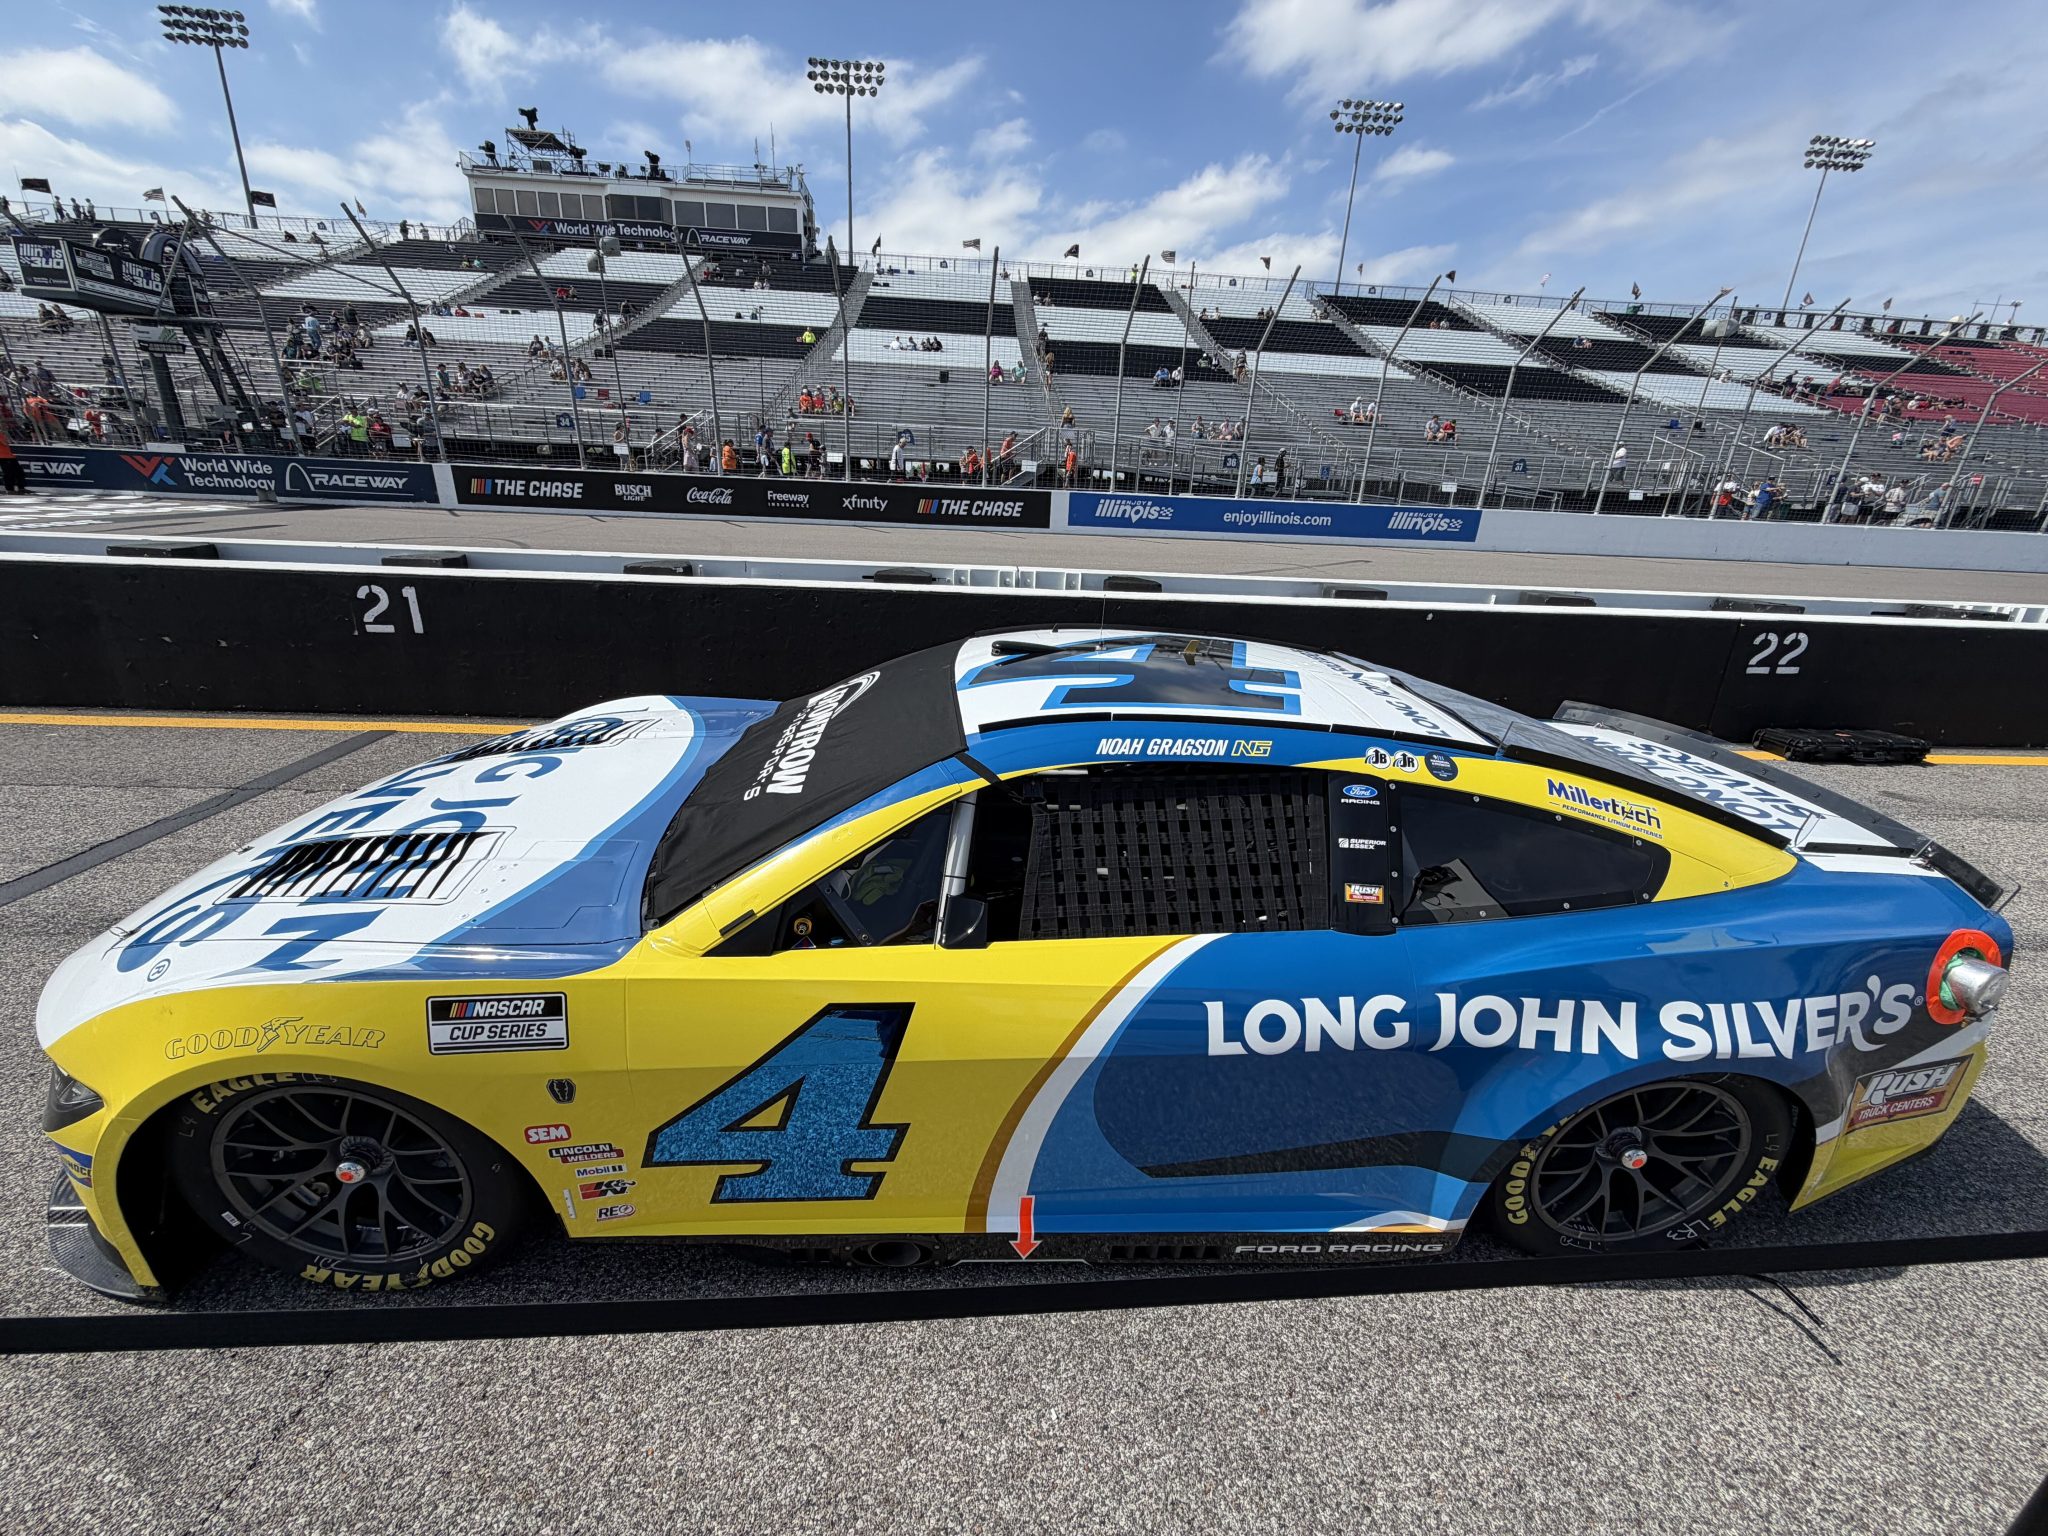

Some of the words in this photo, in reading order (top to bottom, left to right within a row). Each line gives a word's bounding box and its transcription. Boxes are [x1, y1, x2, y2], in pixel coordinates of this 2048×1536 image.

[554, 221, 590, 235] World
[591, 222, 616, 236] Wide
[700, 234, 751, 245] RACEWAY
[18, 243, 64, 260] illinis
[121, 259, 162, 283] illinis
[559, 416, 571, 428] 34
[18, 460, 86, 476] CEWAY
[178, 457, 229, 475] World
[230, 459, 273, 475] Wide
[1226, 457, 1237, 468] 36
[1514, 461, 1524, 472] 37
[183, 472, 276, 491] Technology
[310, 472, 409, 489] RACEWAY
[495, 478, 526, 496] THE
[528, 481, 584, 499] CHASE
[614, 483, 653, 497] BUSCH
[767, 490, 810, 504] Freeway
[842, 496, 889, 512] xfinity
[941, 500, 970, 516] THE
[971, 501, 1025, 517] CHASE
[1095, 499, 1160, 524] illinois
[1223, 509, 1332, 527] enjoyillinois.com
[1387, 511, 1450, 535] illinois
[356, 584, 424, 634] 21
[1745, 632, 1809, 675] 22
[1386, 699, 1453, 738] LONG
[1096, 738, 1145, 755] NOAH
[1147, 738, 1229, 757] GRAGSON
[1577, 735, 1681, 780] JOHN
[1349, 785, 1372, 797] Ford
[1340, 798, 1380, 806] RACING
[1547, 778, 1661, 829] Millertech
[1671, 775, 1801, 831] LONG
[1562, 803, 1606, 821] PERFORMANCE
[1607, 817, 1631, 829] LITHIUM
[1632, 825, 1663, 840] BATTERIES
[1349, 838, 1386, 846] SUPERIOR
[1350, 884, 1379, 896] RUSH
[471, 997, 546, 1018] NASCAR
[1207, 993, 1410, 1056] LONG
[1428, 992, 1638, 1060] JOHN
[1661, 974, 1916, 1060] SILVER'S
[448, 1023, 486, 1041] CUP
[487, 1022, 548, 1040] SERIES
[191, 1073, 298, 1114] EAGLE
[1860, 1062, 1962, 1106] RUSH
[641, 1002, 916, 1204] 4
[1857, 1102, 1889, 1121] TRUCK
[1889, 1095, 1936, 1113] CENTERS
[527, 1126, 568, 1142] SEM
[552, 1143, 610, 1157] LINCOLN
[567, 1151, 617, 1163] WELDERS
[577, 1165, 610, 1177] Mobil
[1708, 1156, 1779, 1230] EAGLE
[1235, 1245, 1322, 1254] FORD
[1327, 1244, 1444, 1253] RACING
